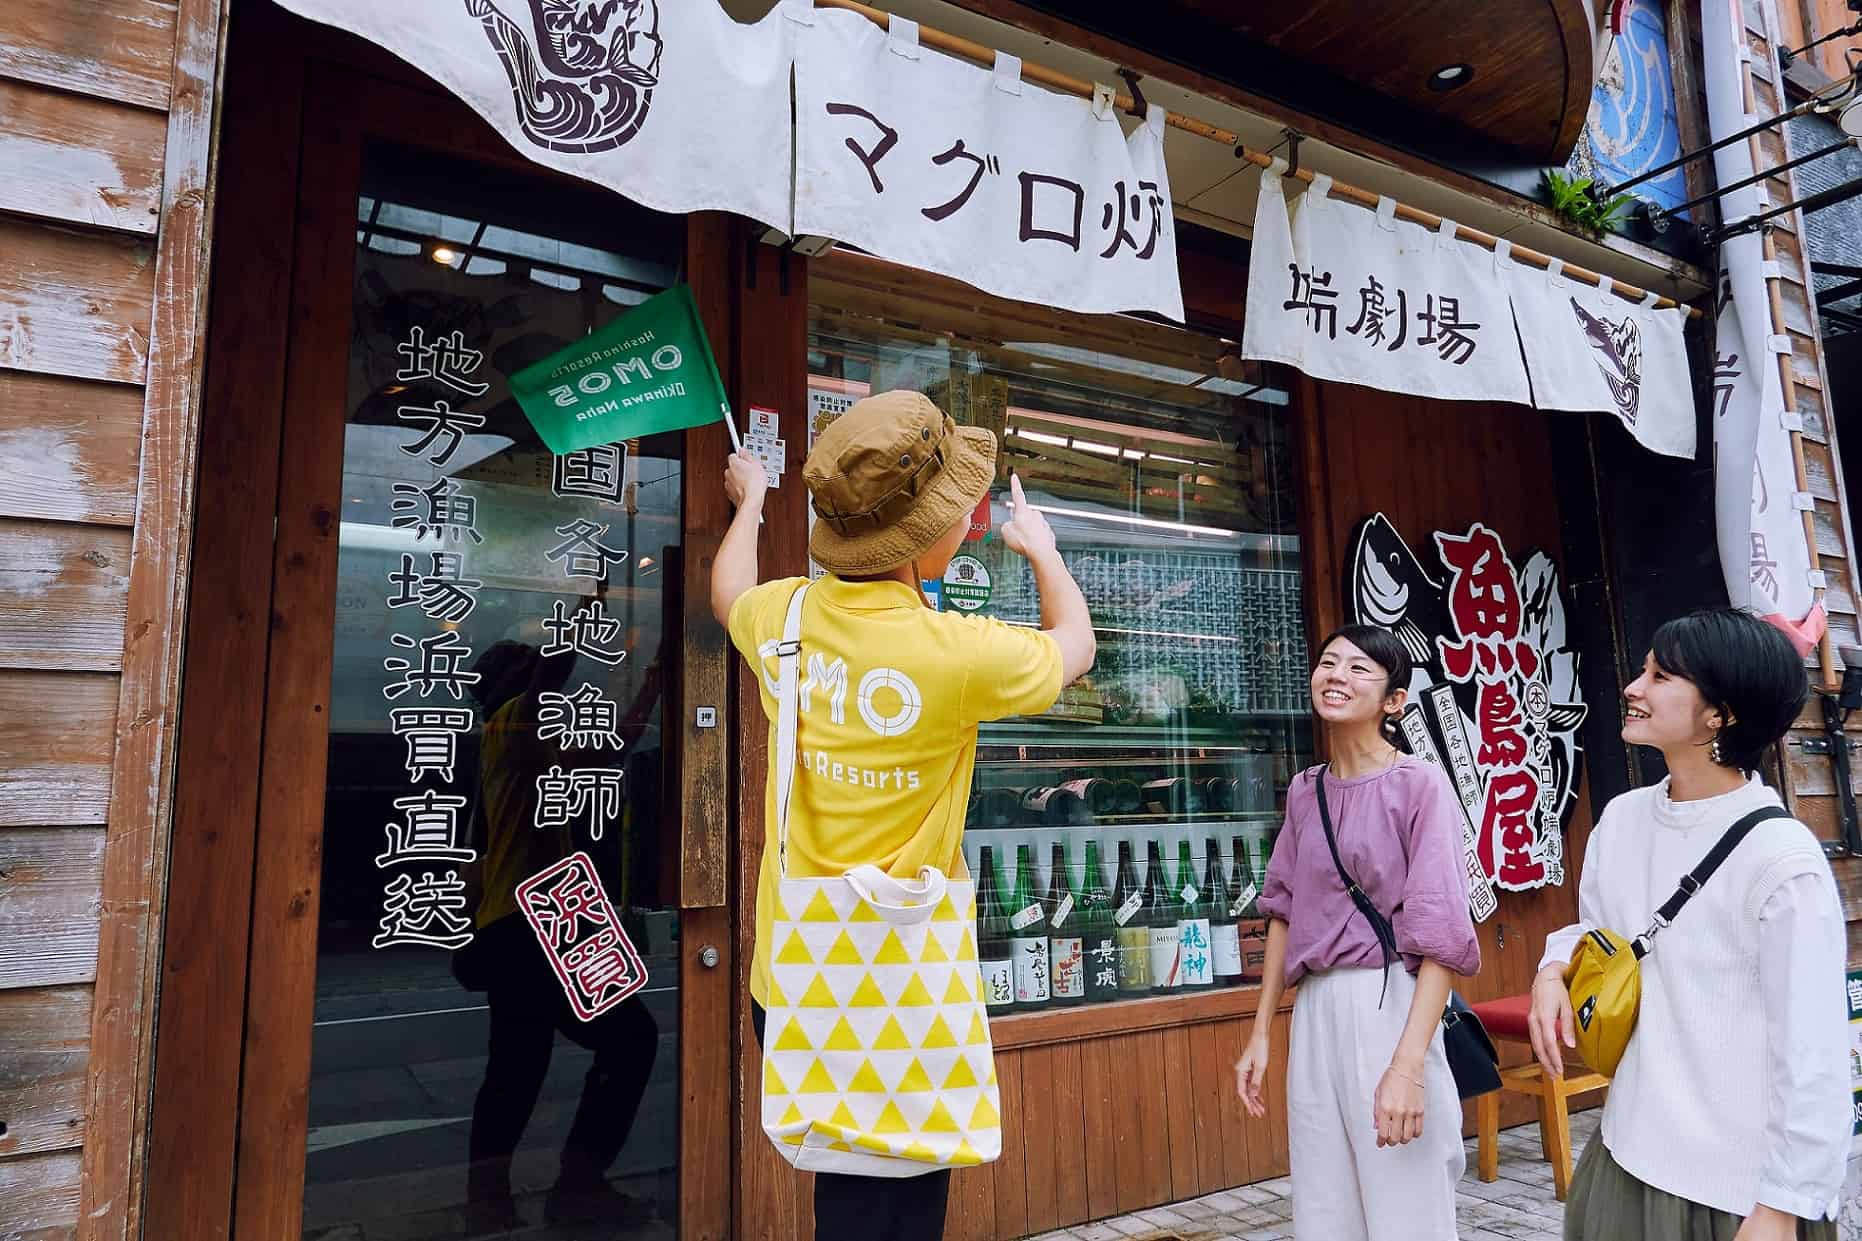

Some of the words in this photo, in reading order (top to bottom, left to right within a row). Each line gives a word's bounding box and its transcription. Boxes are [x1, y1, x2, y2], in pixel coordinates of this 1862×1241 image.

[371, 325, 490, 951] 地方漁場浜買直送
[528, 865, 631, 1009] 浜買
[1178, 921, 1207, 980] 龍神
